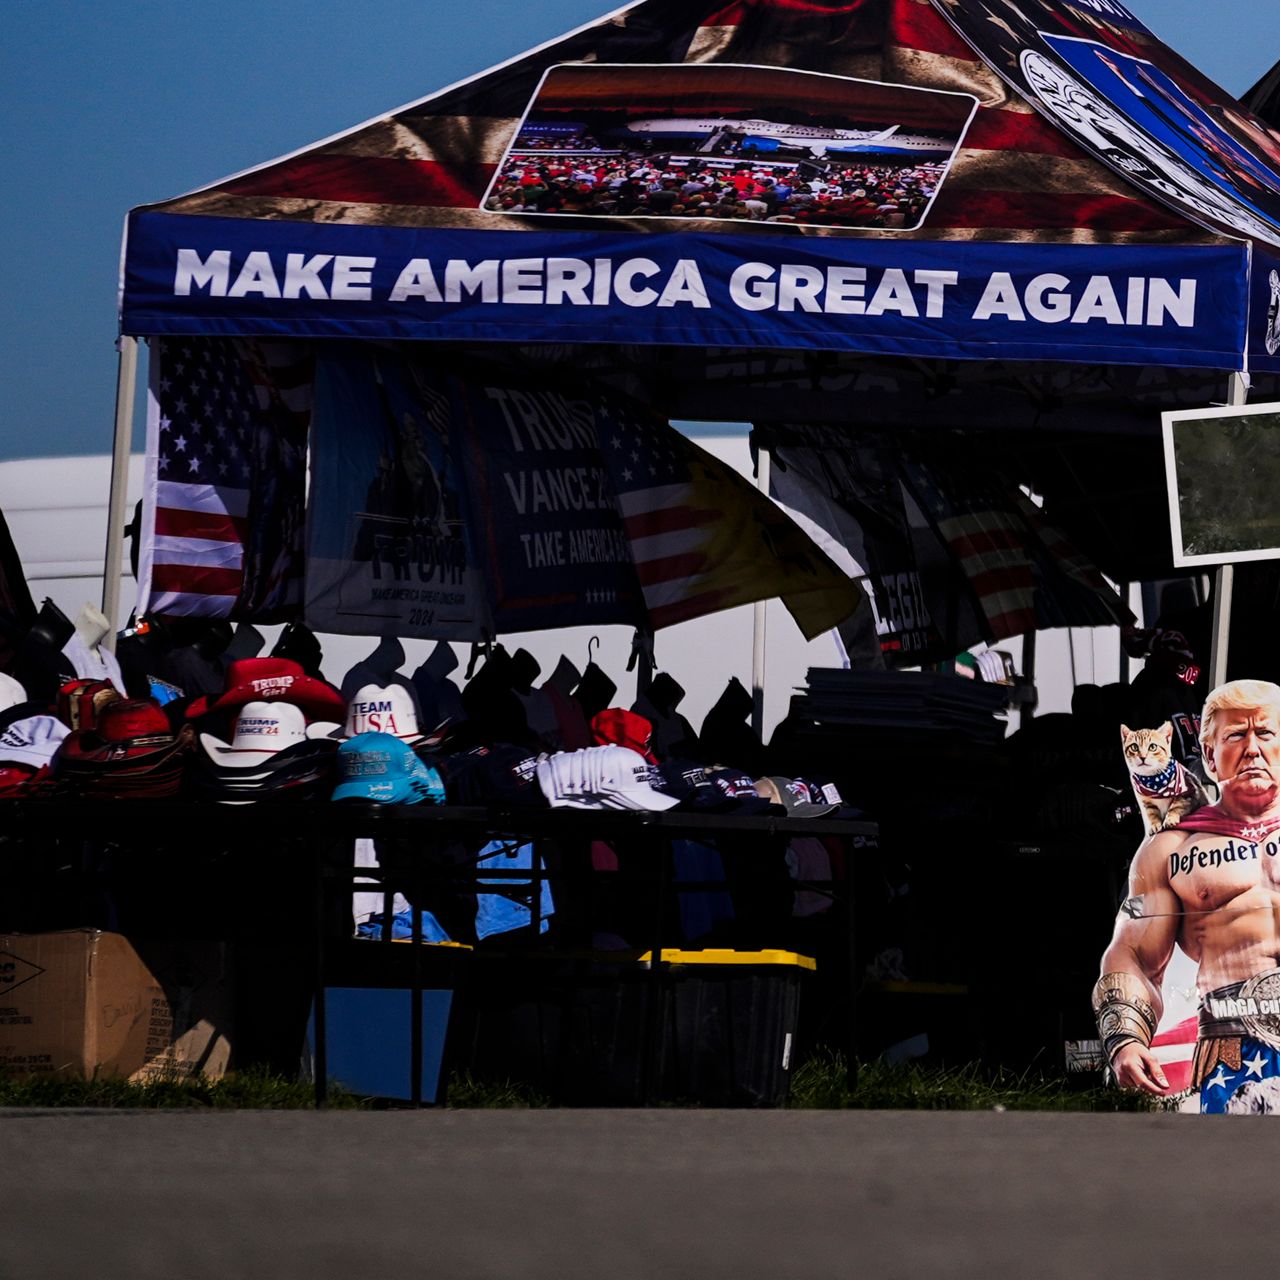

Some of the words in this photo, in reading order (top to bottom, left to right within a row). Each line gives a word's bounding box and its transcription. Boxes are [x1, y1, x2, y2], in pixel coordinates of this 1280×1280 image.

[174, 249, 376, 301] MAKE
[388, 257, 711, 309] AMERICA
[729, 263, 959, 319] GREAT
[973, 272, 1197, 328] AGAIN
[504, 466, 590, 515] VANCE
[521, 531, 566, 569] TAKE
[408, 608, 435, 626] 2024
[251, 676, 295, 693] TRUMP
[352, 701, 392, 713] TEAM
[352, 712, 399, 736] USA
[1170, 840, 1258, 878] Defender
[1210, 997, 1258, 1019] MAGA
